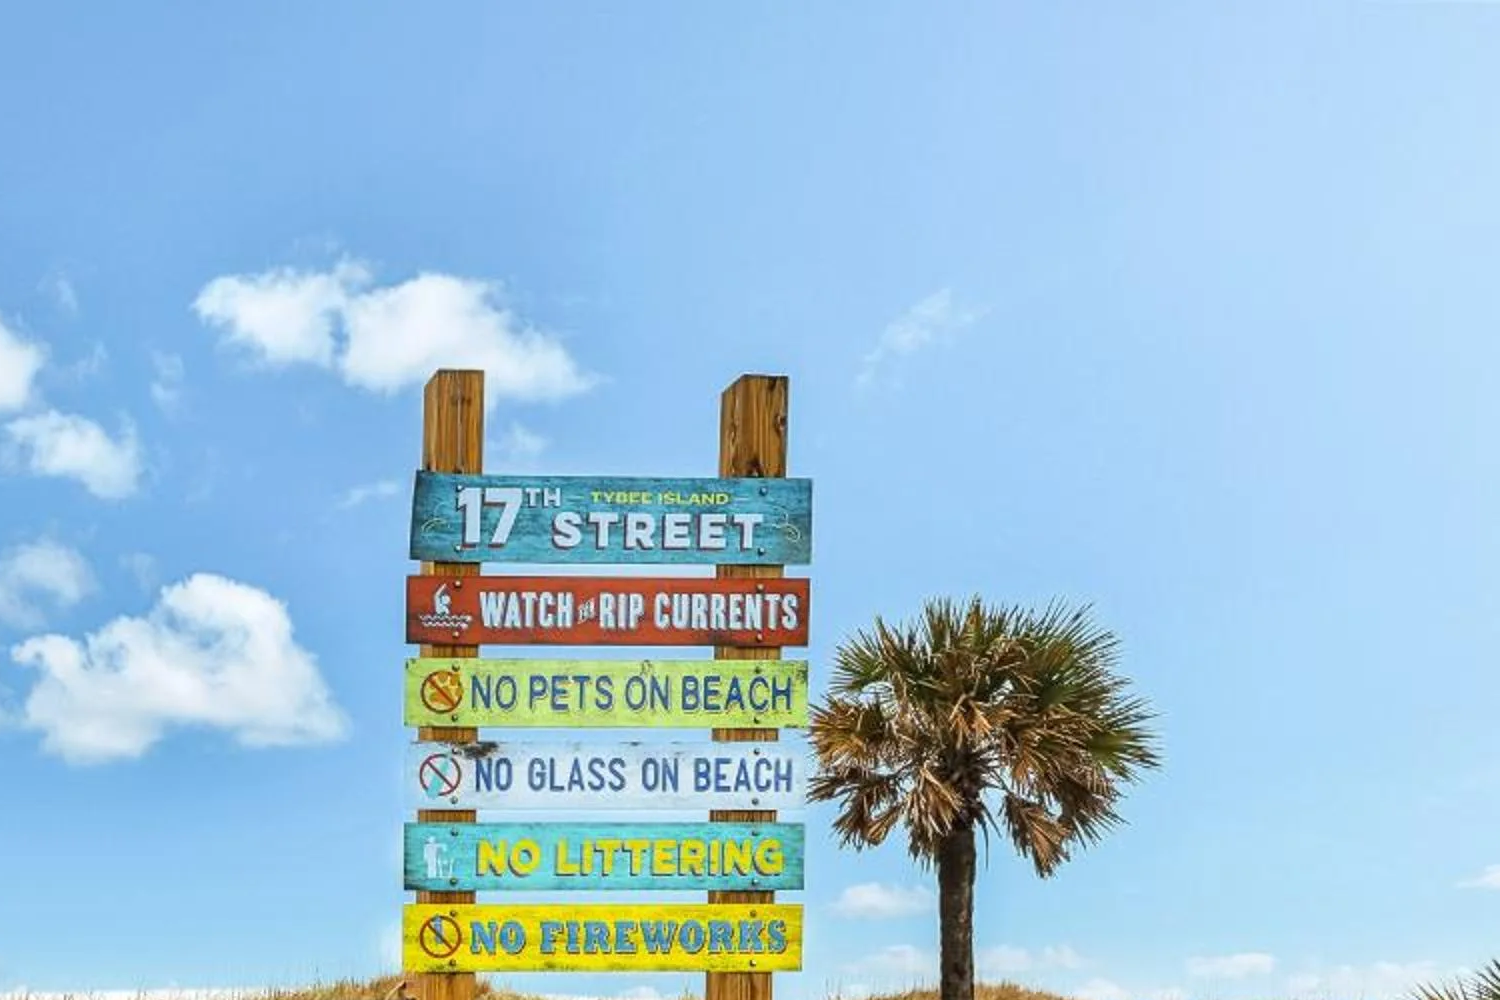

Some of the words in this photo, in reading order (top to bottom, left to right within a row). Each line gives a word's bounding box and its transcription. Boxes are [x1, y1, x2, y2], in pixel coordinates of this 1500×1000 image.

[589, 491, 653, 505] TYBEE
[659, 492, 730, 505] ISLAND
[456, 487, 561, 548] 17TH
[552, 511, 764, 550] STREET
[479, 591, 573, 629] WATCH
[599, 592, 645, 630] RIP
[654, 592, 799, 631] CURRENTS
[470, 675, 518, 711] NO
[529, 675, 614, 711] PETS
[624, 675, 672, 711] ON
[680, 675, 793, 711] BEACH
[474, 758, 513, 792] NO
[527, 757, 627, 792] GLASS
[641, 758, 679, 792] ON
[693, 758, 793, 793] BEACH
[475, 839, 541, 877] NO
[555, 839, 784, 878] LITTERING
[469, 920, 526, 955] NO
[538, 920, 788, 956] FIREWORKS
